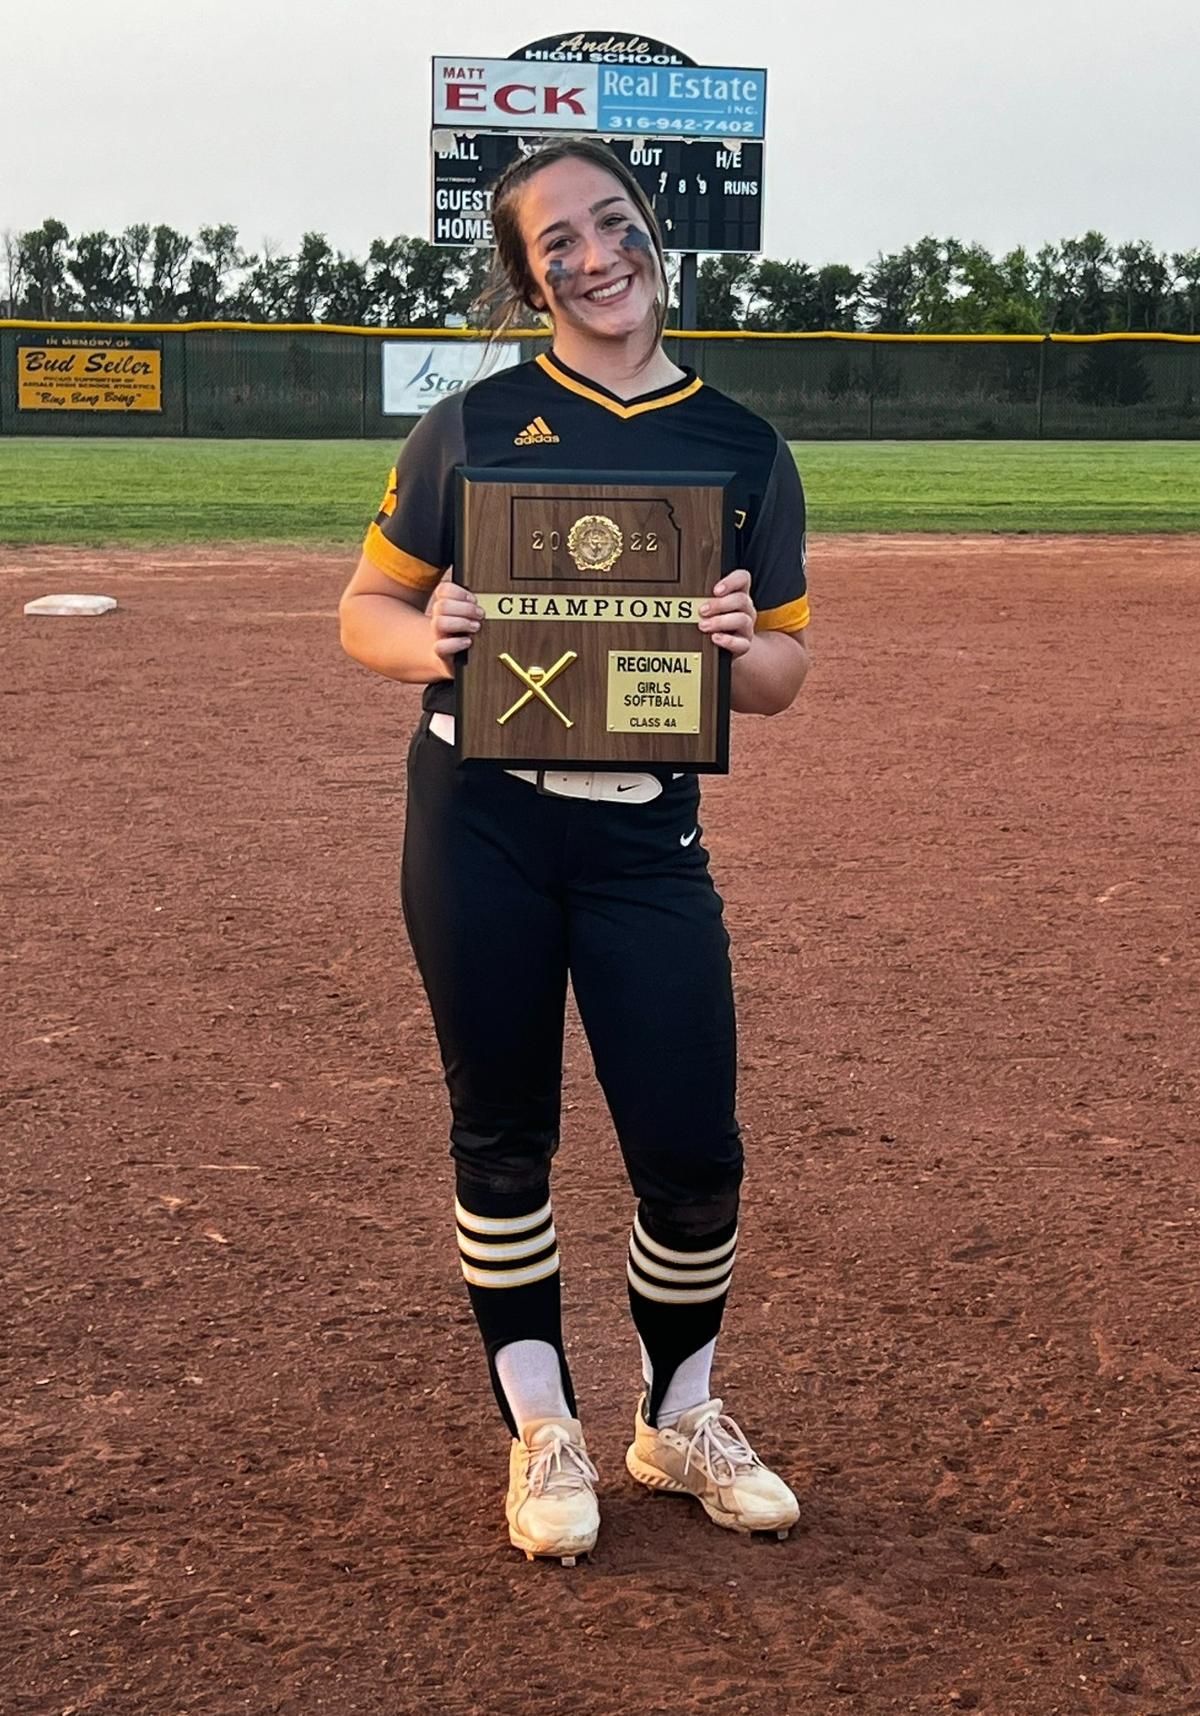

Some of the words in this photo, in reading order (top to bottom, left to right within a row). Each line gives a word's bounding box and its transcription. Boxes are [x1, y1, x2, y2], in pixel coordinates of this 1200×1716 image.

[555, 33, 649, 53] Andale
[525, 50, 583, 61] HIGH
[589, 52, 682, 65] SCHOOL
[443, 67, 485, 79] MATT
[603, 70, 658, 97] Real
[669, 72, 757, 101] Estate
[445, 83, 587, 115] ECK
[727, 105, 758, 115] INC.
[609, 116, 754, 132] 316-942-7402
[630, 148, 662, 166] OUT
[716, 150, 742, 170] H/E
[678, 179, 687, 194] 8
[699, 180, 707, 194] 9
[724, 181, 758, 195] RUNS
[436, 189, 493, 210] GUEST
[437, 218, 493, 239] HOME
[25, 352, 76, 372] Bud
[84, 353, 153, 375] Seiler
[513, 434, 560, 446] adidas
[497, 597, 693, 619] CHAMPIONS
[616, 656, 692, 674] REGIONAL
[637, 682, 671, 694] GIRLS
[623, 694, 684, 708] SOFTBALL
[629, 717, 660, 728] CLASS
[663, 718, 677, 728] 4A
